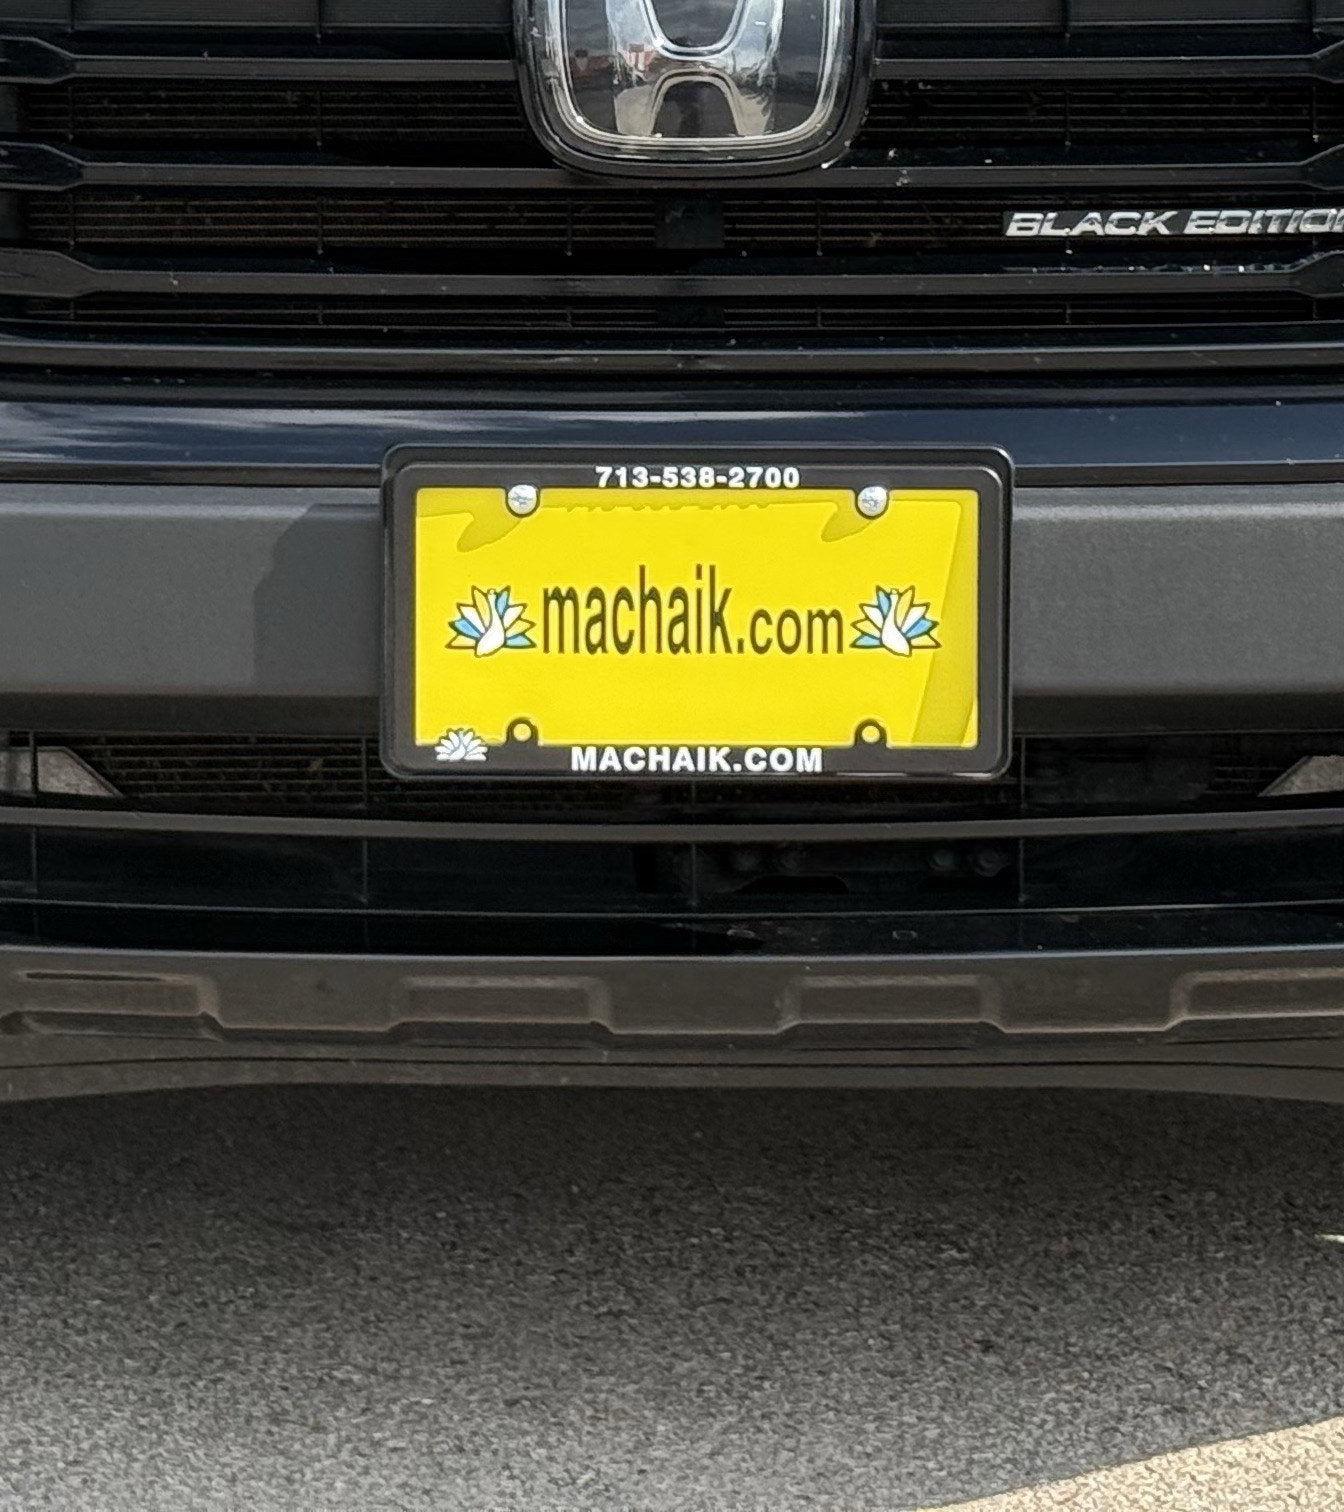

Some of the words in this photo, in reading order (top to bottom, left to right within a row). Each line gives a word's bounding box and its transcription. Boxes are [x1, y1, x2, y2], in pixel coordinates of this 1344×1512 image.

[1005, 211, 1178, 236] BLACK
[595, 466, 800, 488] 713-538-2700
[541, 564, 843, 654] machaik.com
[571, 747, 823, 772] MACHAIK.COM
